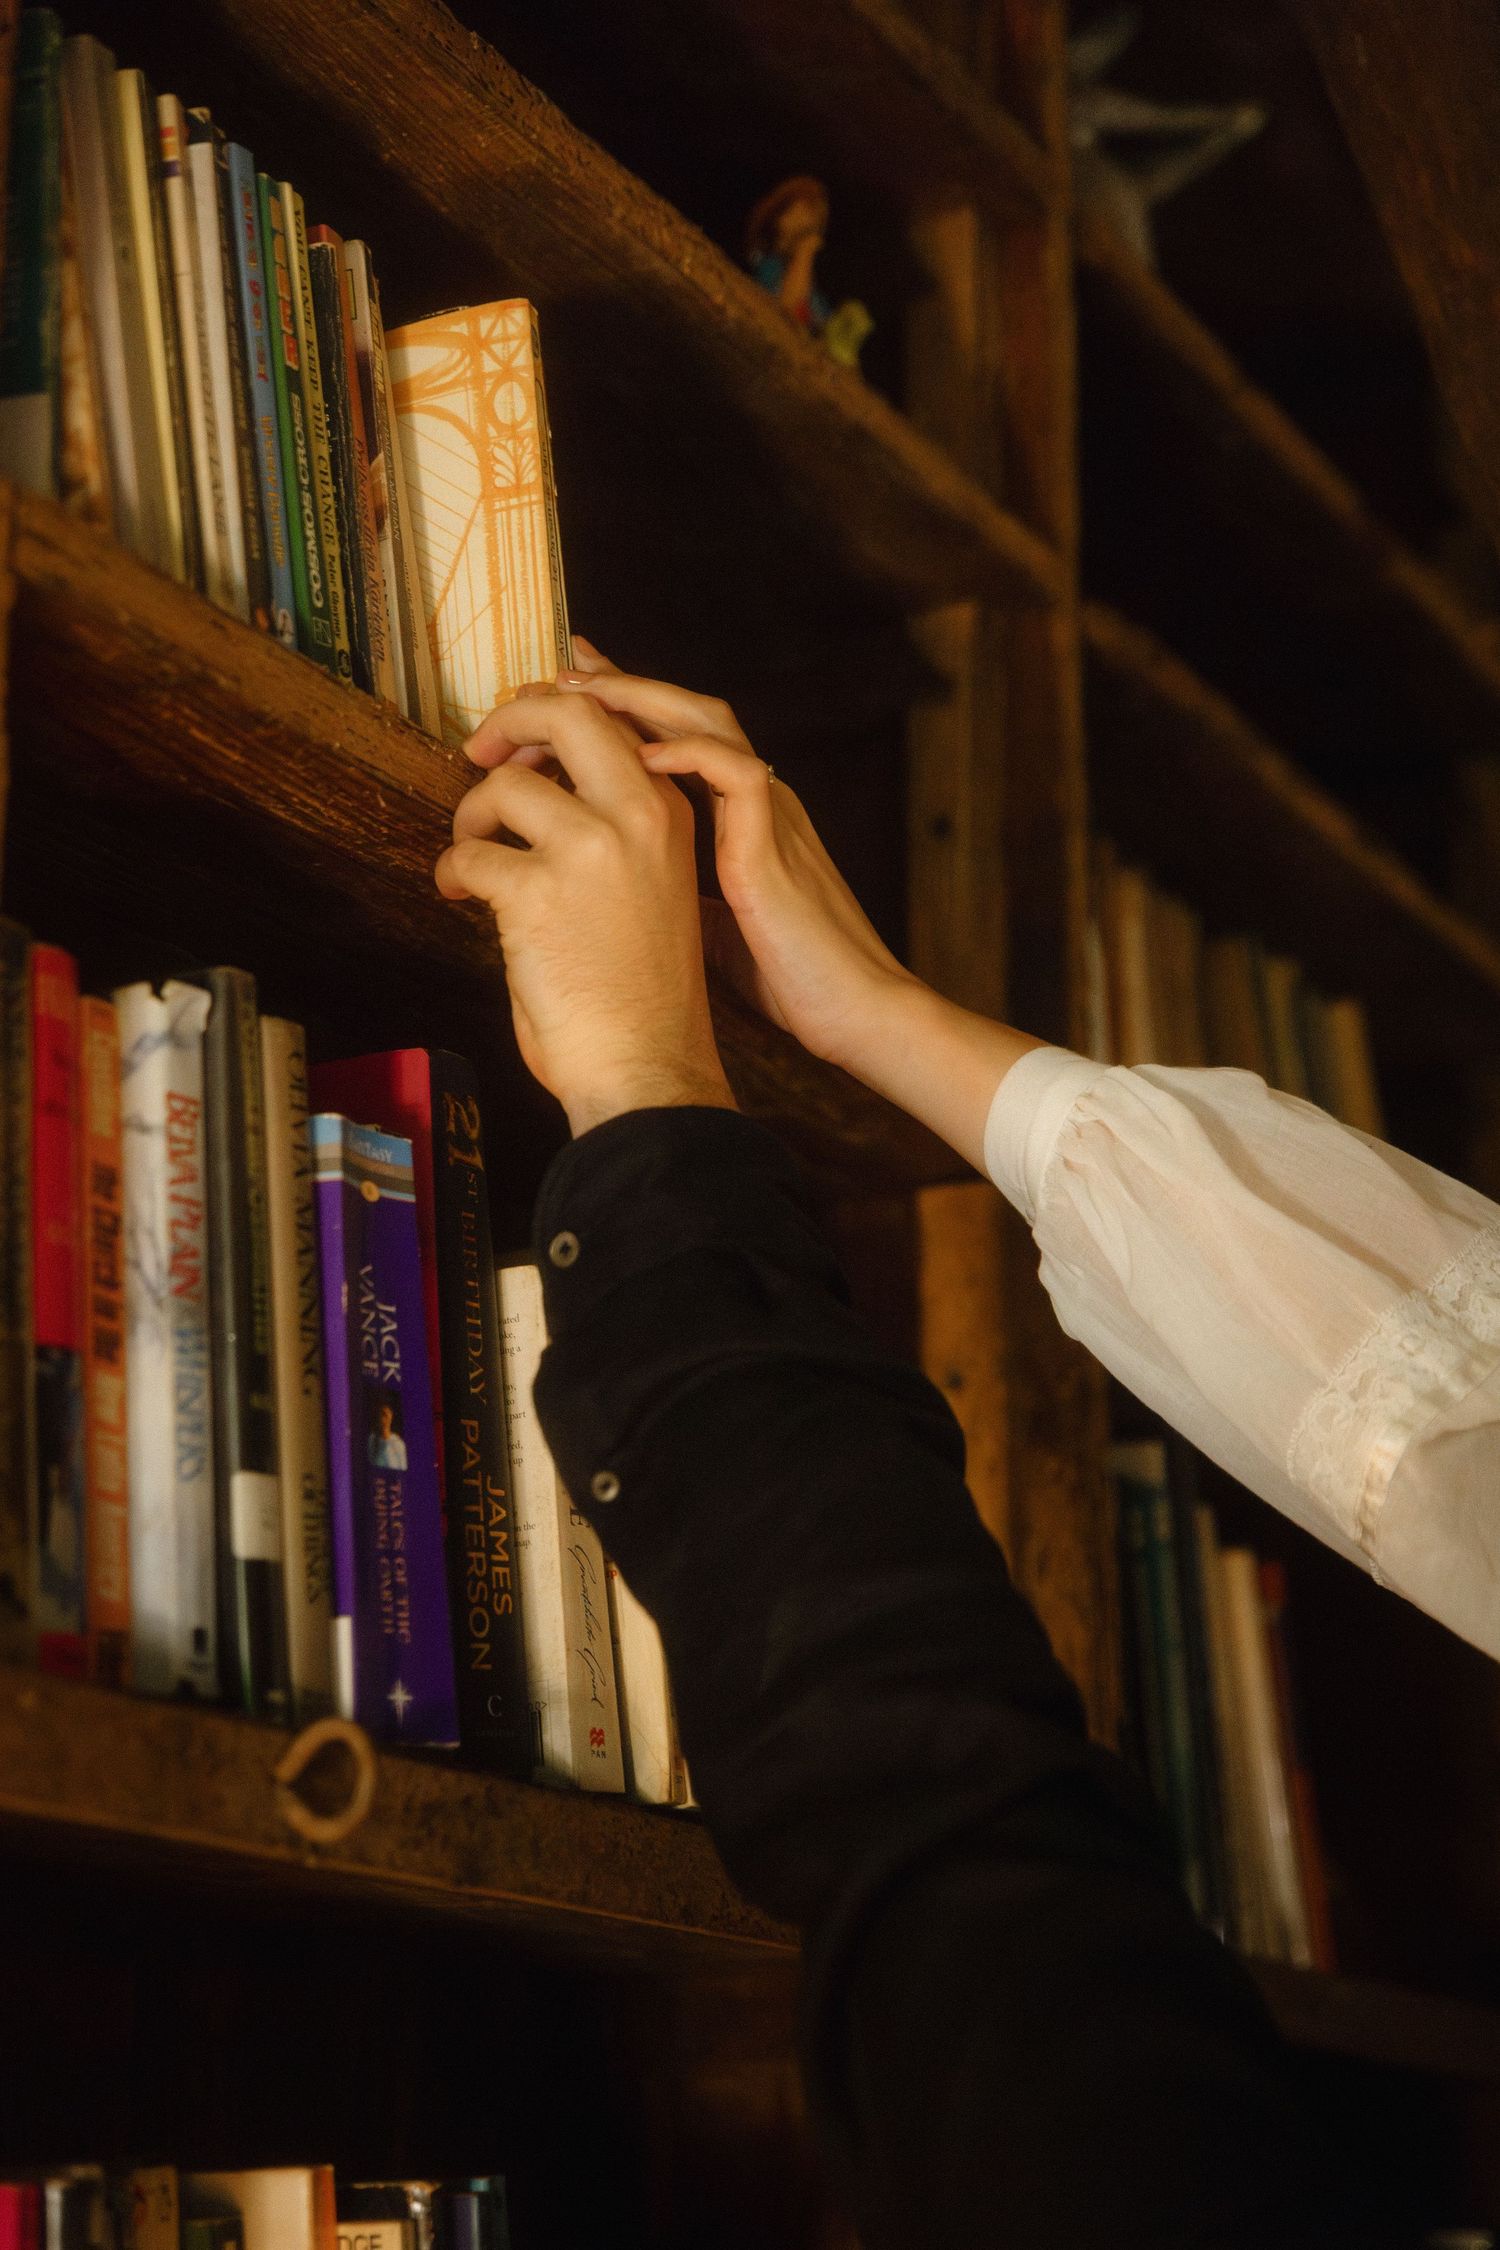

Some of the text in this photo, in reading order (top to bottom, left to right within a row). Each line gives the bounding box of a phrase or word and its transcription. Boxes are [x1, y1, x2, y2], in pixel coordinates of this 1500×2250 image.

[306, 339, 319, 391] KEEP
[312, 402, 325, 445] THE
[317, 454, 335, 546] CHANGE
[554, 601, 564, 656] Aragon
[294, 1195, 321, 1398] MANNING
[356, 1263, 382, 1380] VANCE
[375, 1299, 402, 1384] JACK
[458, 1208, 487, 1407] BIRTHDAY
[458, 1417, 493, 1673] PATTERSON
[483, 1473, 514, 1617] JAMES
[591, 1750, 607, 1759] PAN
